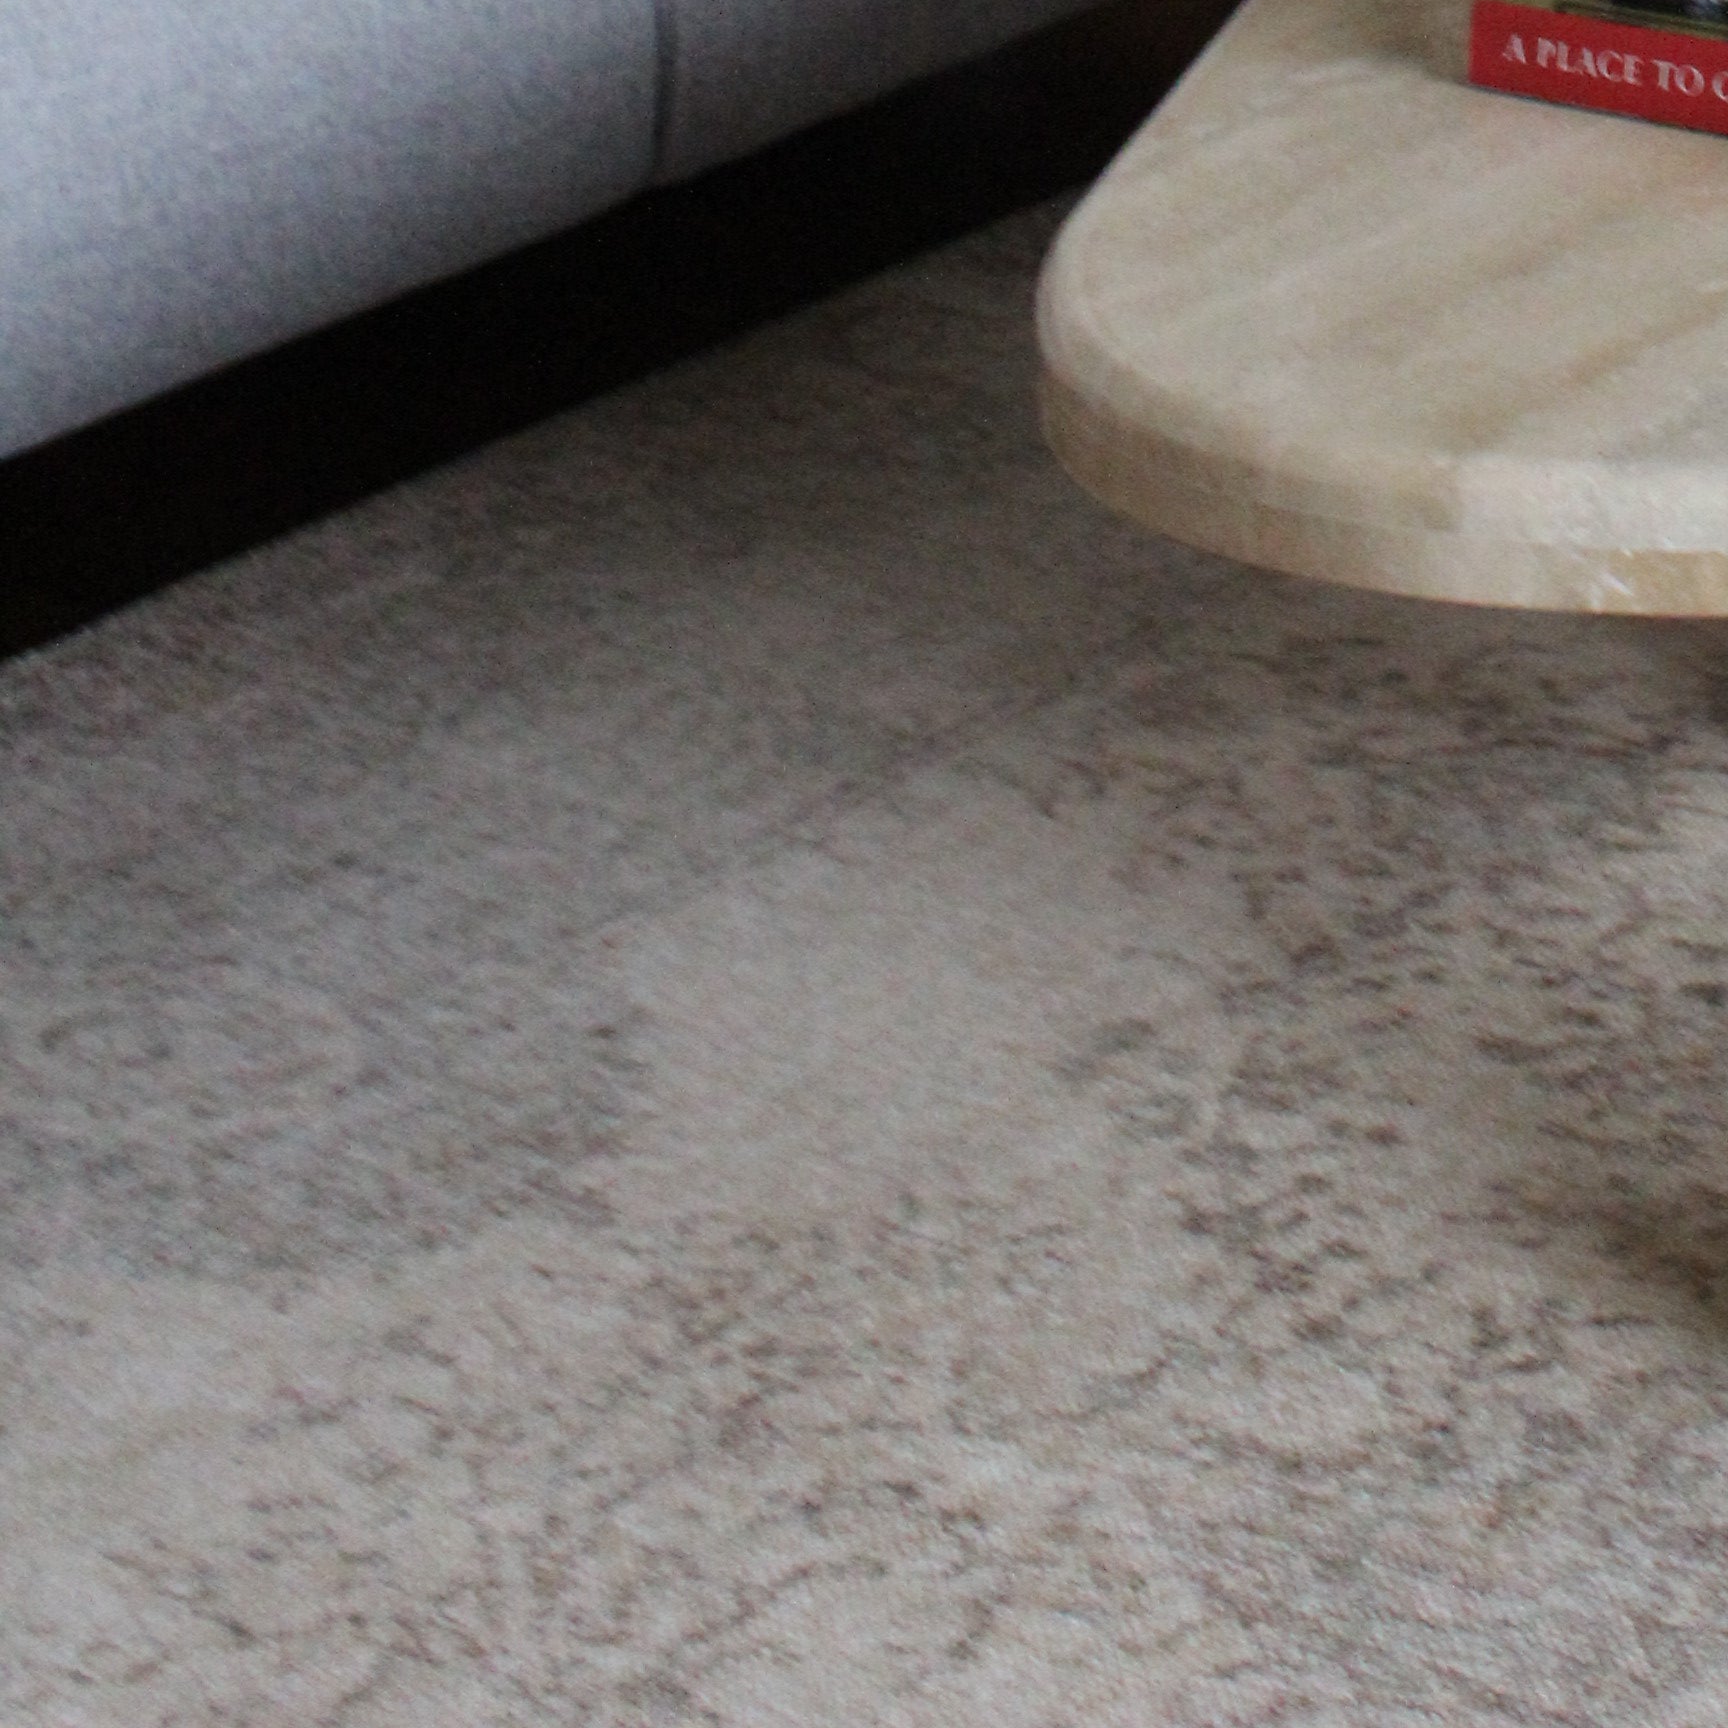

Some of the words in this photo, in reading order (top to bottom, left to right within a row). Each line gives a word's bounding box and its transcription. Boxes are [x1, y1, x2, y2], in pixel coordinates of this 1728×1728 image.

[1502, 32, 1527, 64] A
[1536, 36, 1644, 85] PLACE
[1652, 58, 1704, 97] TO
